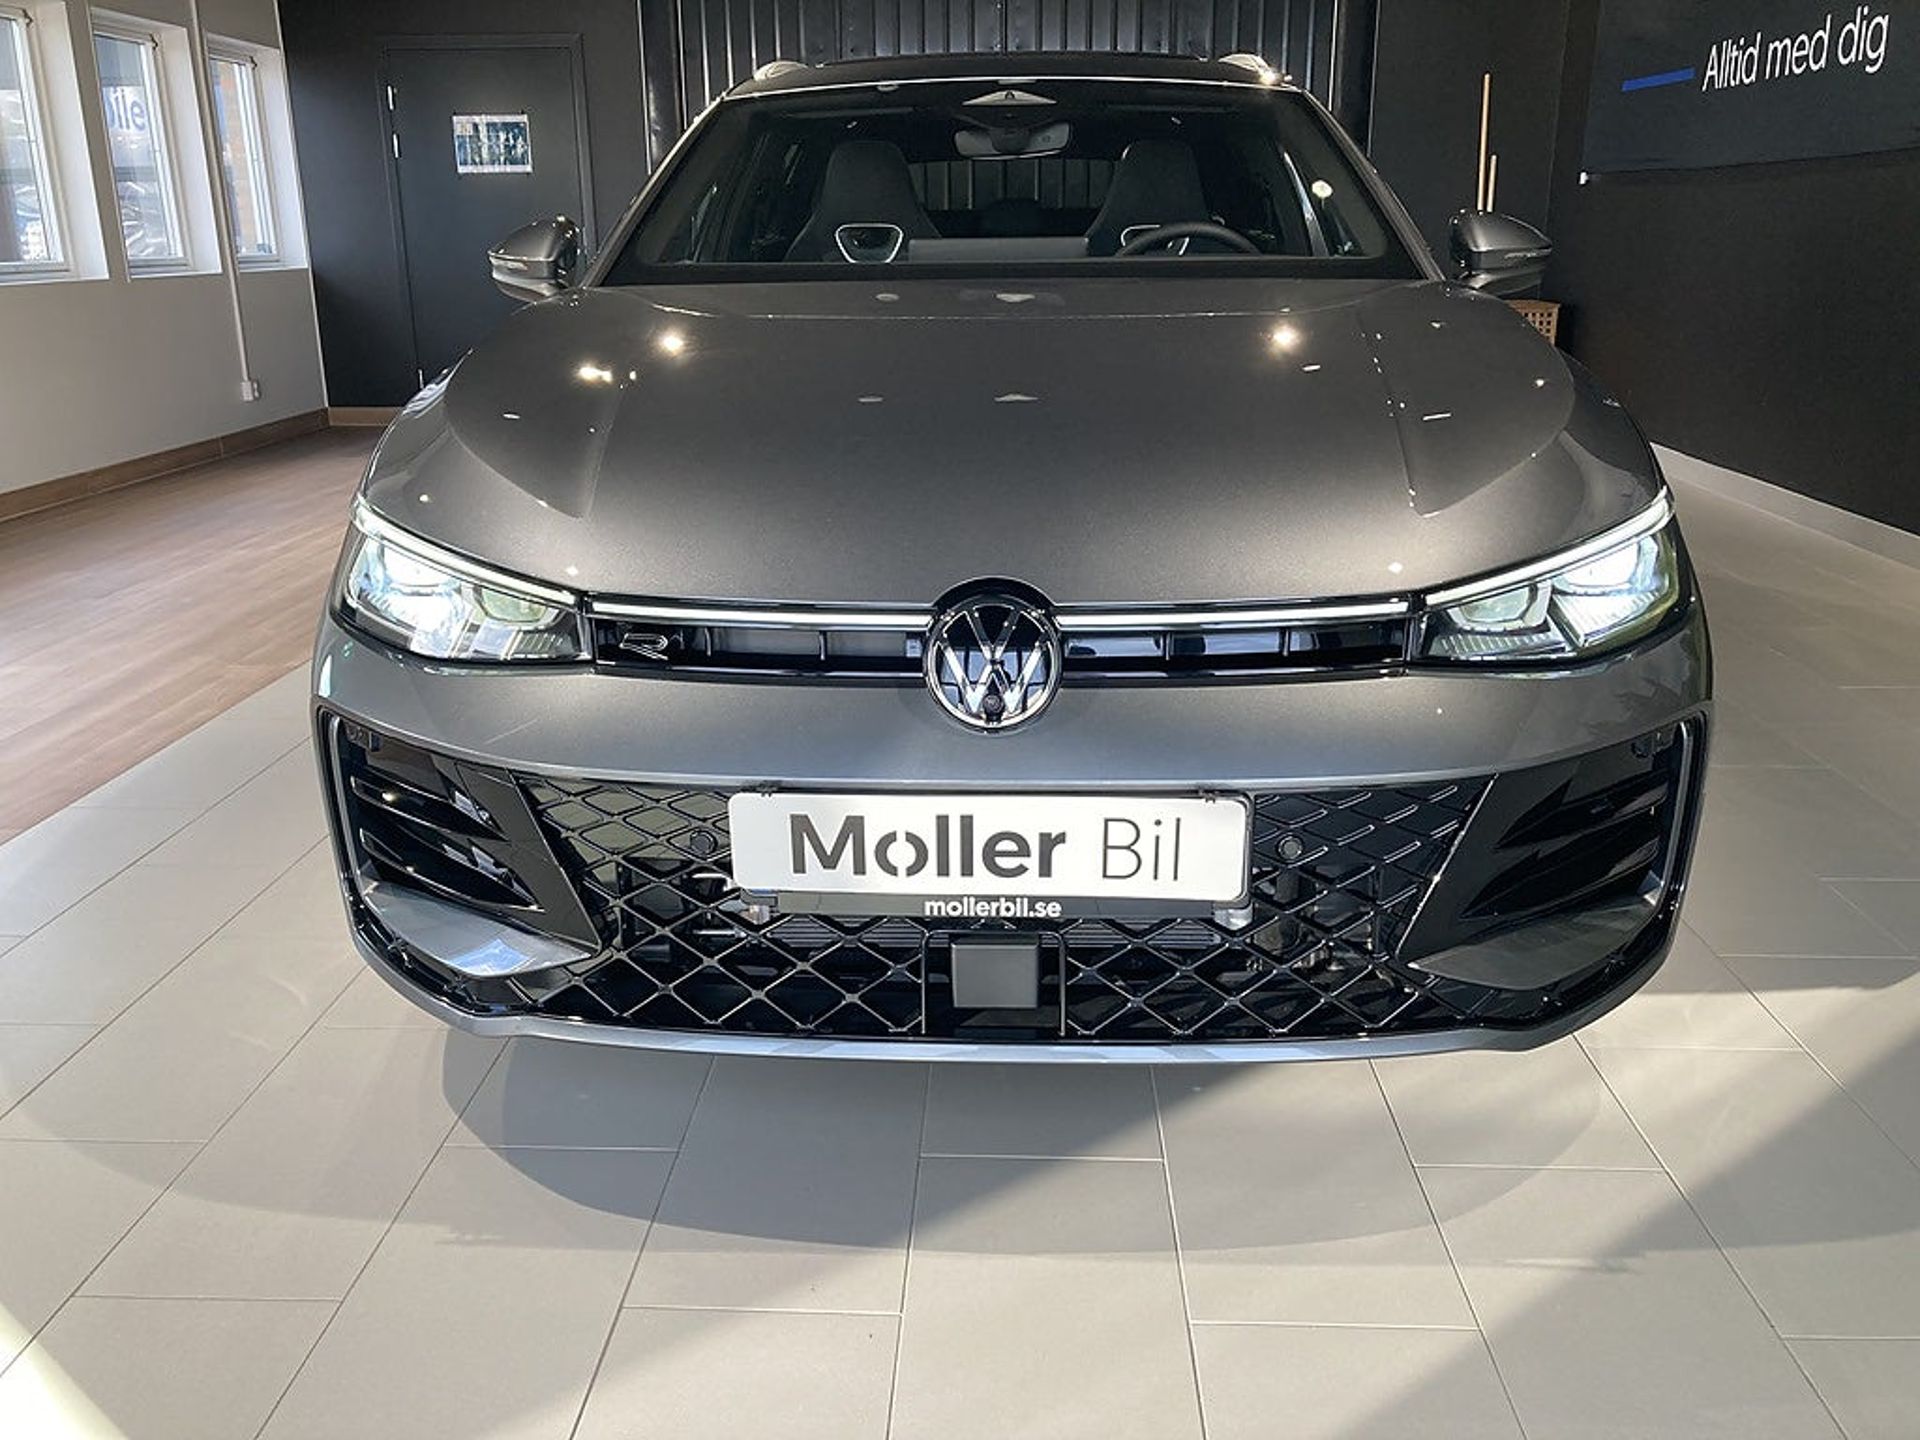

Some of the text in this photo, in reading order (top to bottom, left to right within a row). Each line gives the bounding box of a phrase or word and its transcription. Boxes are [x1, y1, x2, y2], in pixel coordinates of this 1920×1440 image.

[1702, 5, 1889, 92] Alltid med dig
[1102, 816, 1181, 882] Bil
[924, 897, 1062, 919] mollerbil.se
